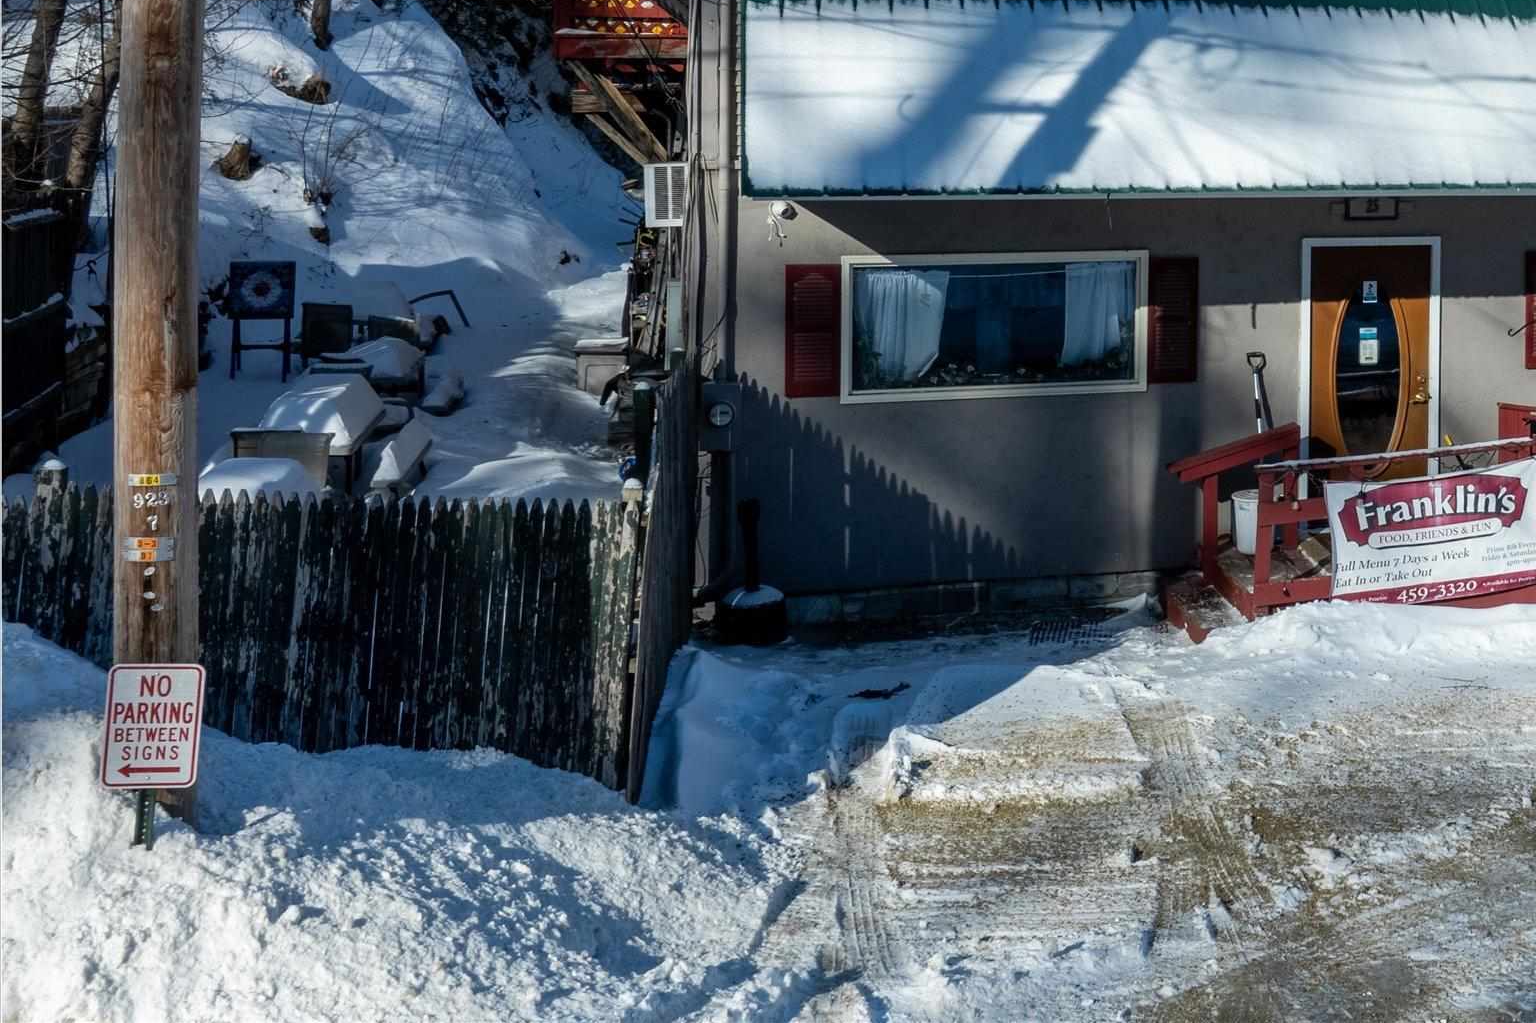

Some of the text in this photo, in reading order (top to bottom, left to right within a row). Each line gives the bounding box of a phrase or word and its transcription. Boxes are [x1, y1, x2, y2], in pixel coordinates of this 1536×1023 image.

[1356, 484, 1516, 531] Franklin's
[1378, 521, 1492, 545] FOOD, FRIENDS & FUN
[1336, 560, 1356, 573] Full
[1358, 558, 1391, 570] Menu
[1393, 558, 1400, 567] 7
[1402, 554, 1429, 565] Days
[1441, 547, 1471, 562] Week
[1335, 568, 1433, 589] Eat In or Take Out
[1397, 580, 1477, 604] 459-3320
[140, 675, 172, 697] NO
[112, 702, 194, 724] PARKING
[114, 727, 190, 743] BETWEEN
[121, 745, 180, 761] SIGNS
